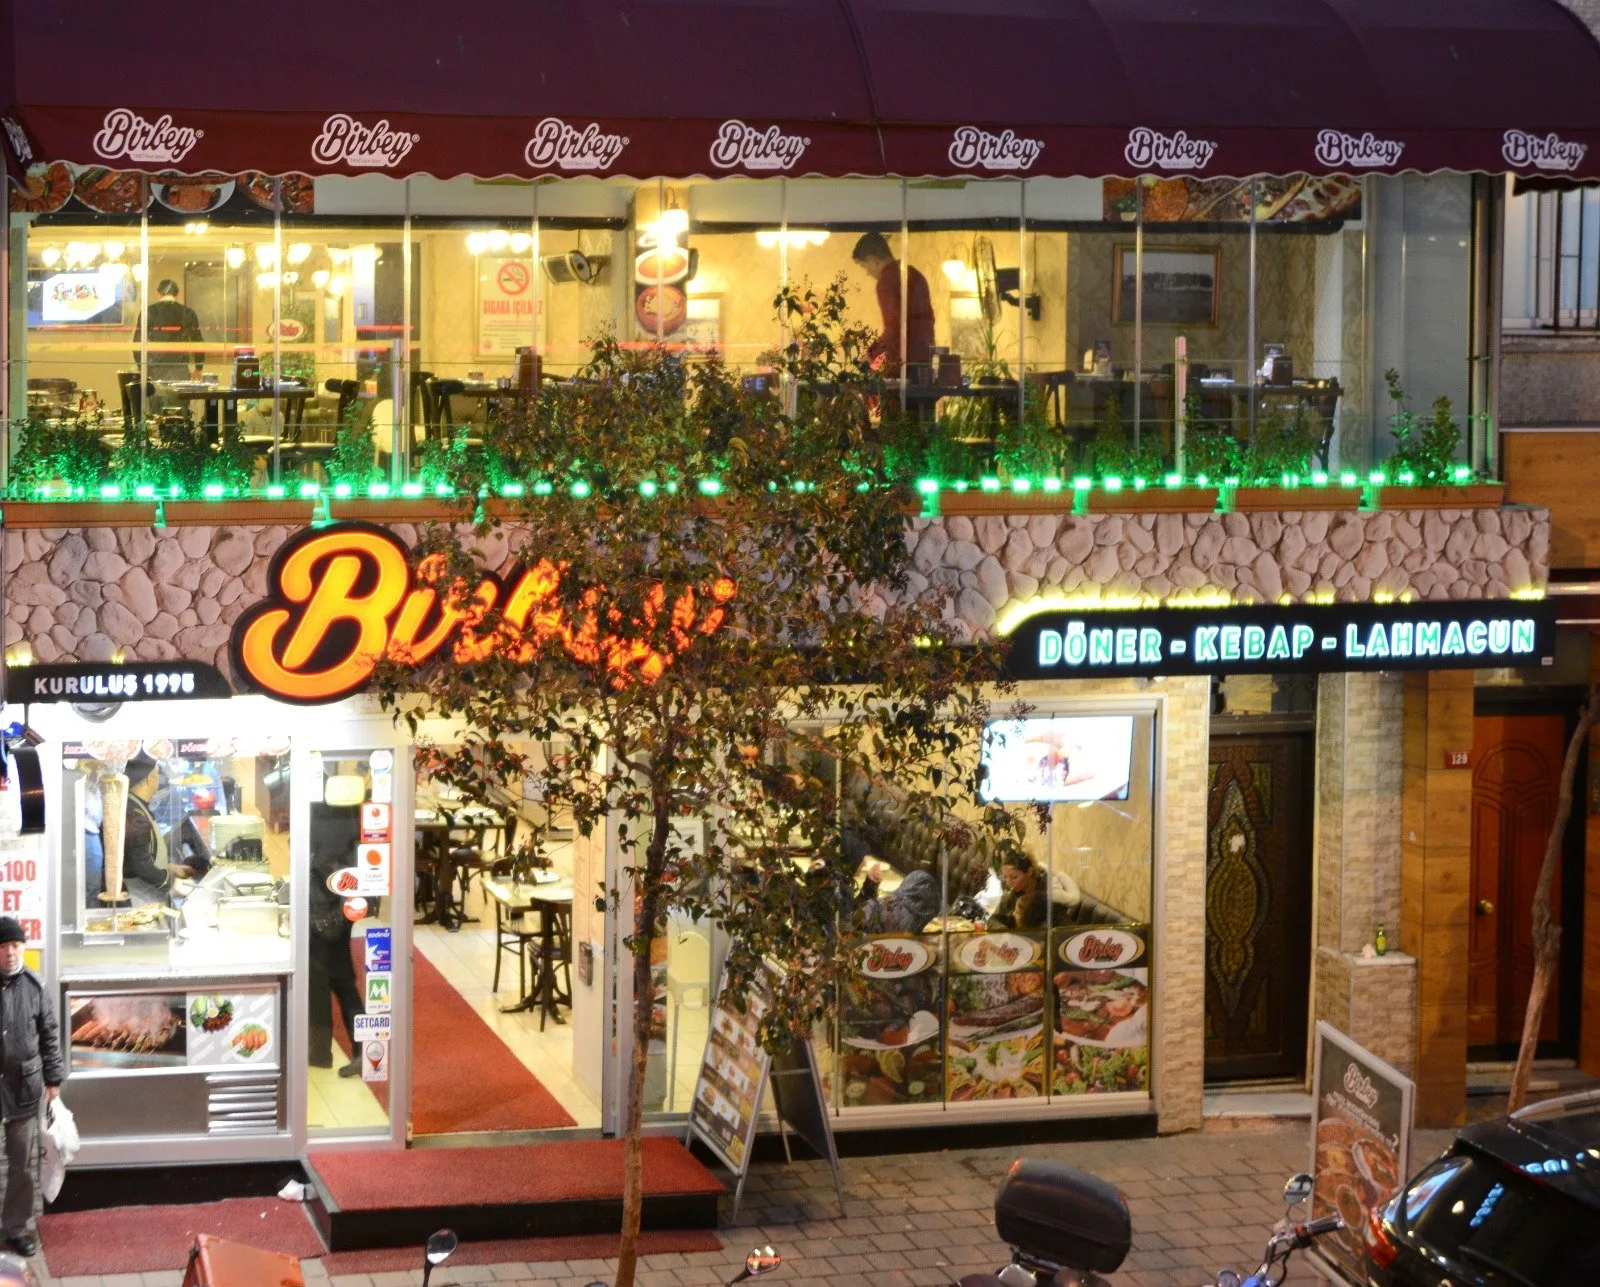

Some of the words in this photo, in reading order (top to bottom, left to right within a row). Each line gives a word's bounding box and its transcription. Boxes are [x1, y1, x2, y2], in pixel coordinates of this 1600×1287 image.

[93, 108, 197, 163] Birbey
[311, 113, 413, 167] Birbey
[525, 117, 623, 169] Birbey
[710, 119, 805, 169] Birbey
[948, 126, 1040, 169] Birbey
[1124, 127, 1213, 169] Birbey
[1315, 129, 1401, 167] Birbey
[1502, 129, 1584, 170] Birbey
[1039, 621, 1162, 666] DÖNER
[1194, 625, 1315, 663] KEBAP
[1345, 619, 1536, 658] LAHMACUN
[34, 674, 138, 696] KURULUŞ
[143, 673, 195, 693] 1995
[0, 859, 36, 882] 100
[3, 890, 23, 911] ET
[1079, 935, 1124, 963] Birbey
[355, 1017, 390, 1029] SETCARD
